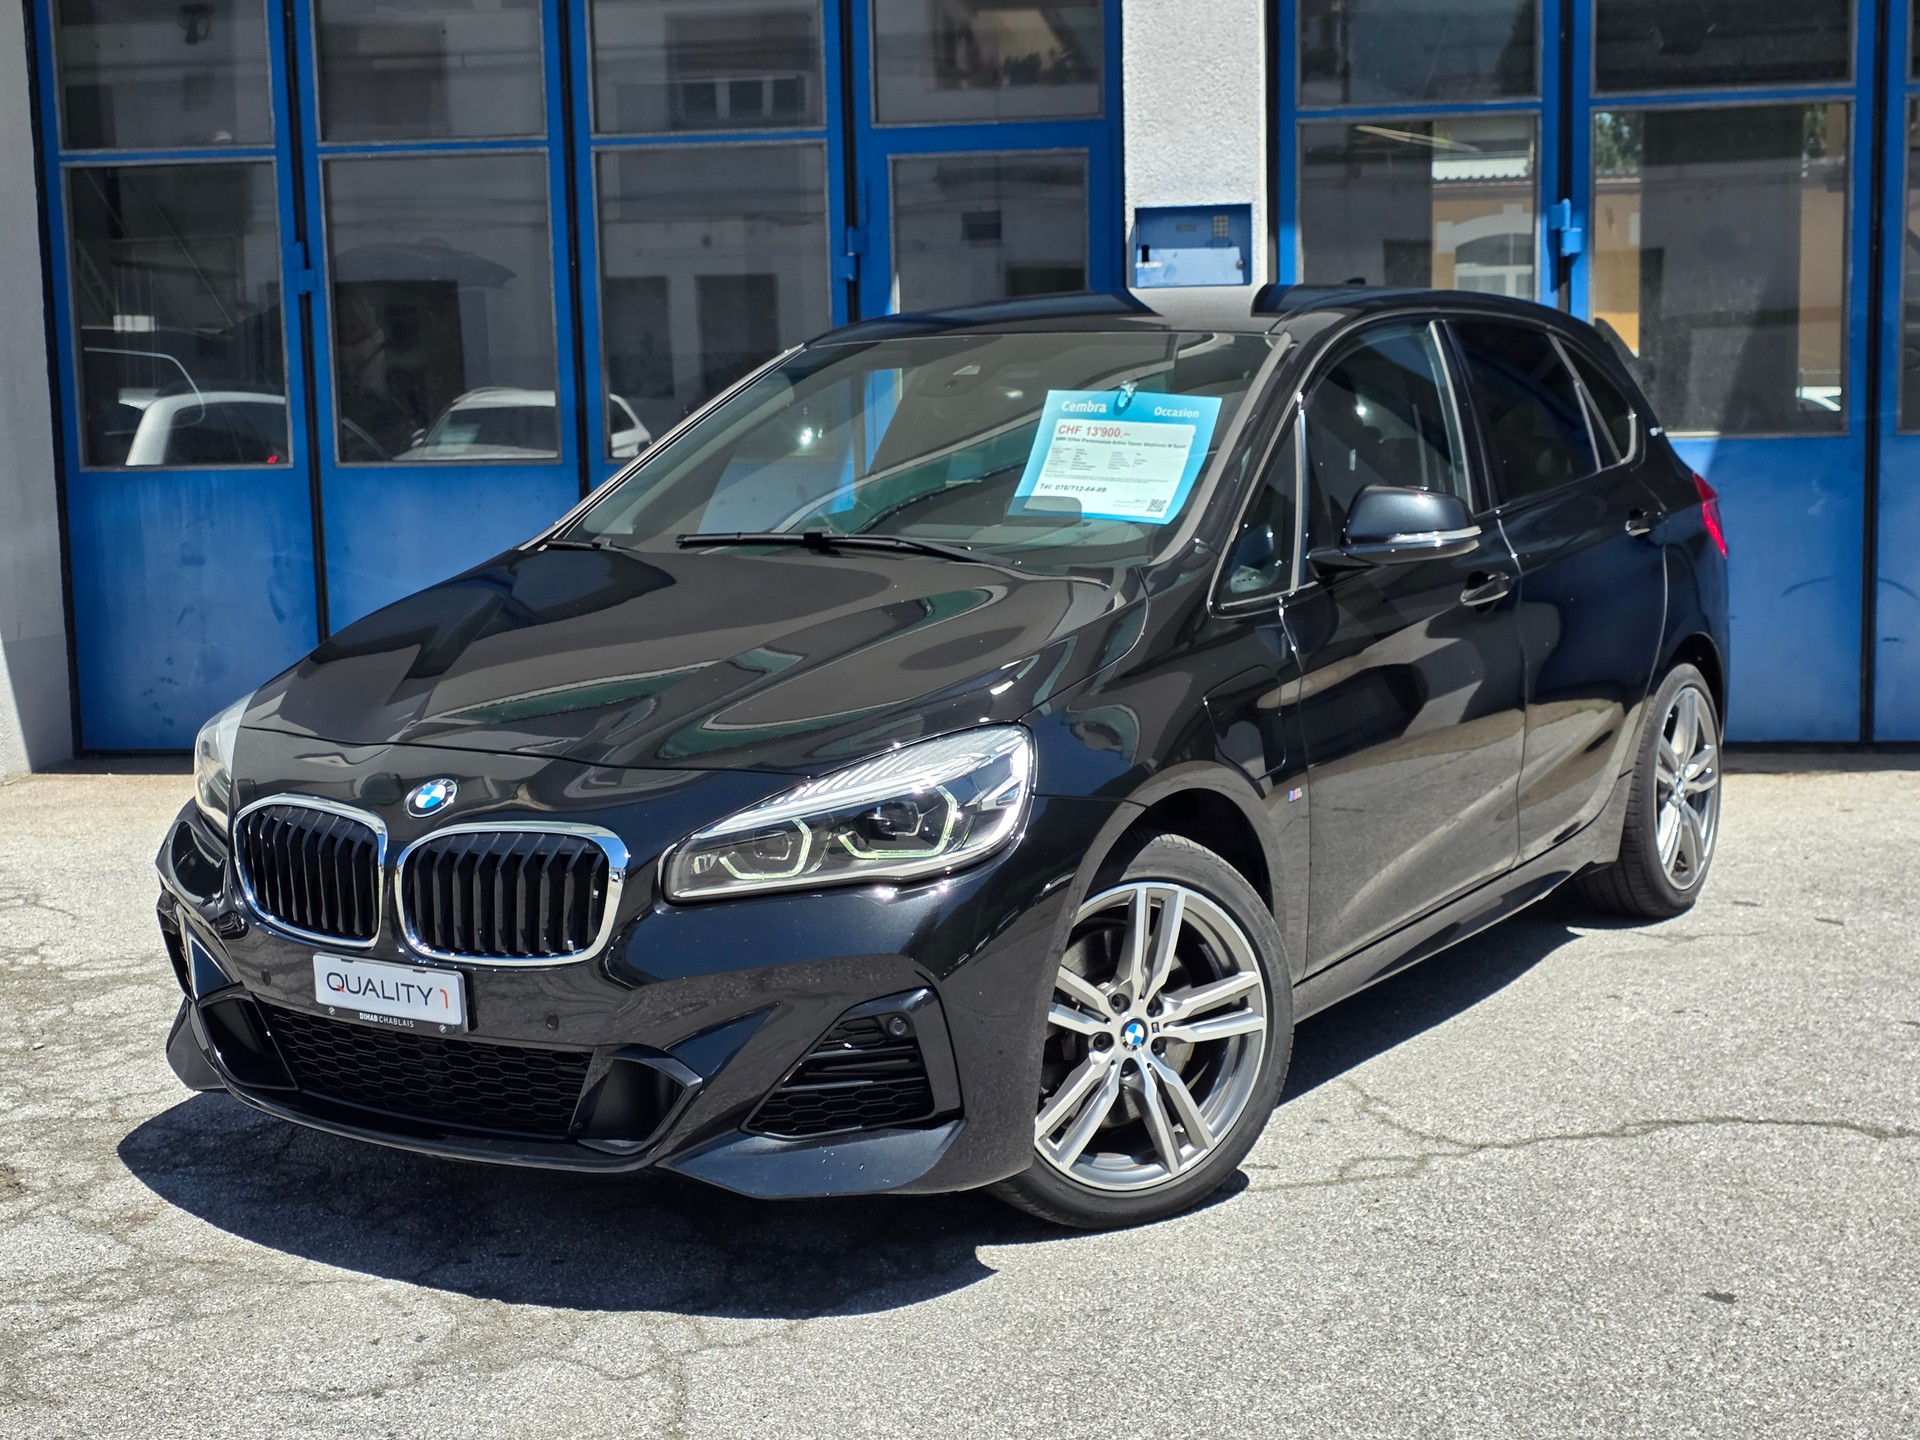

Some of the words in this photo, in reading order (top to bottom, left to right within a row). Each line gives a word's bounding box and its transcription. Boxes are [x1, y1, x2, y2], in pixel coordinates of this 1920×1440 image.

[1061, 400, 1107, 414] Cembra
[1154, 406, 1200, 418] Occasion
[1058, 424, 1083, 436] CHF
[326, 971, 434, 1006] QUALITY
[379, 1017, 415, 1028] CHABLAIS
